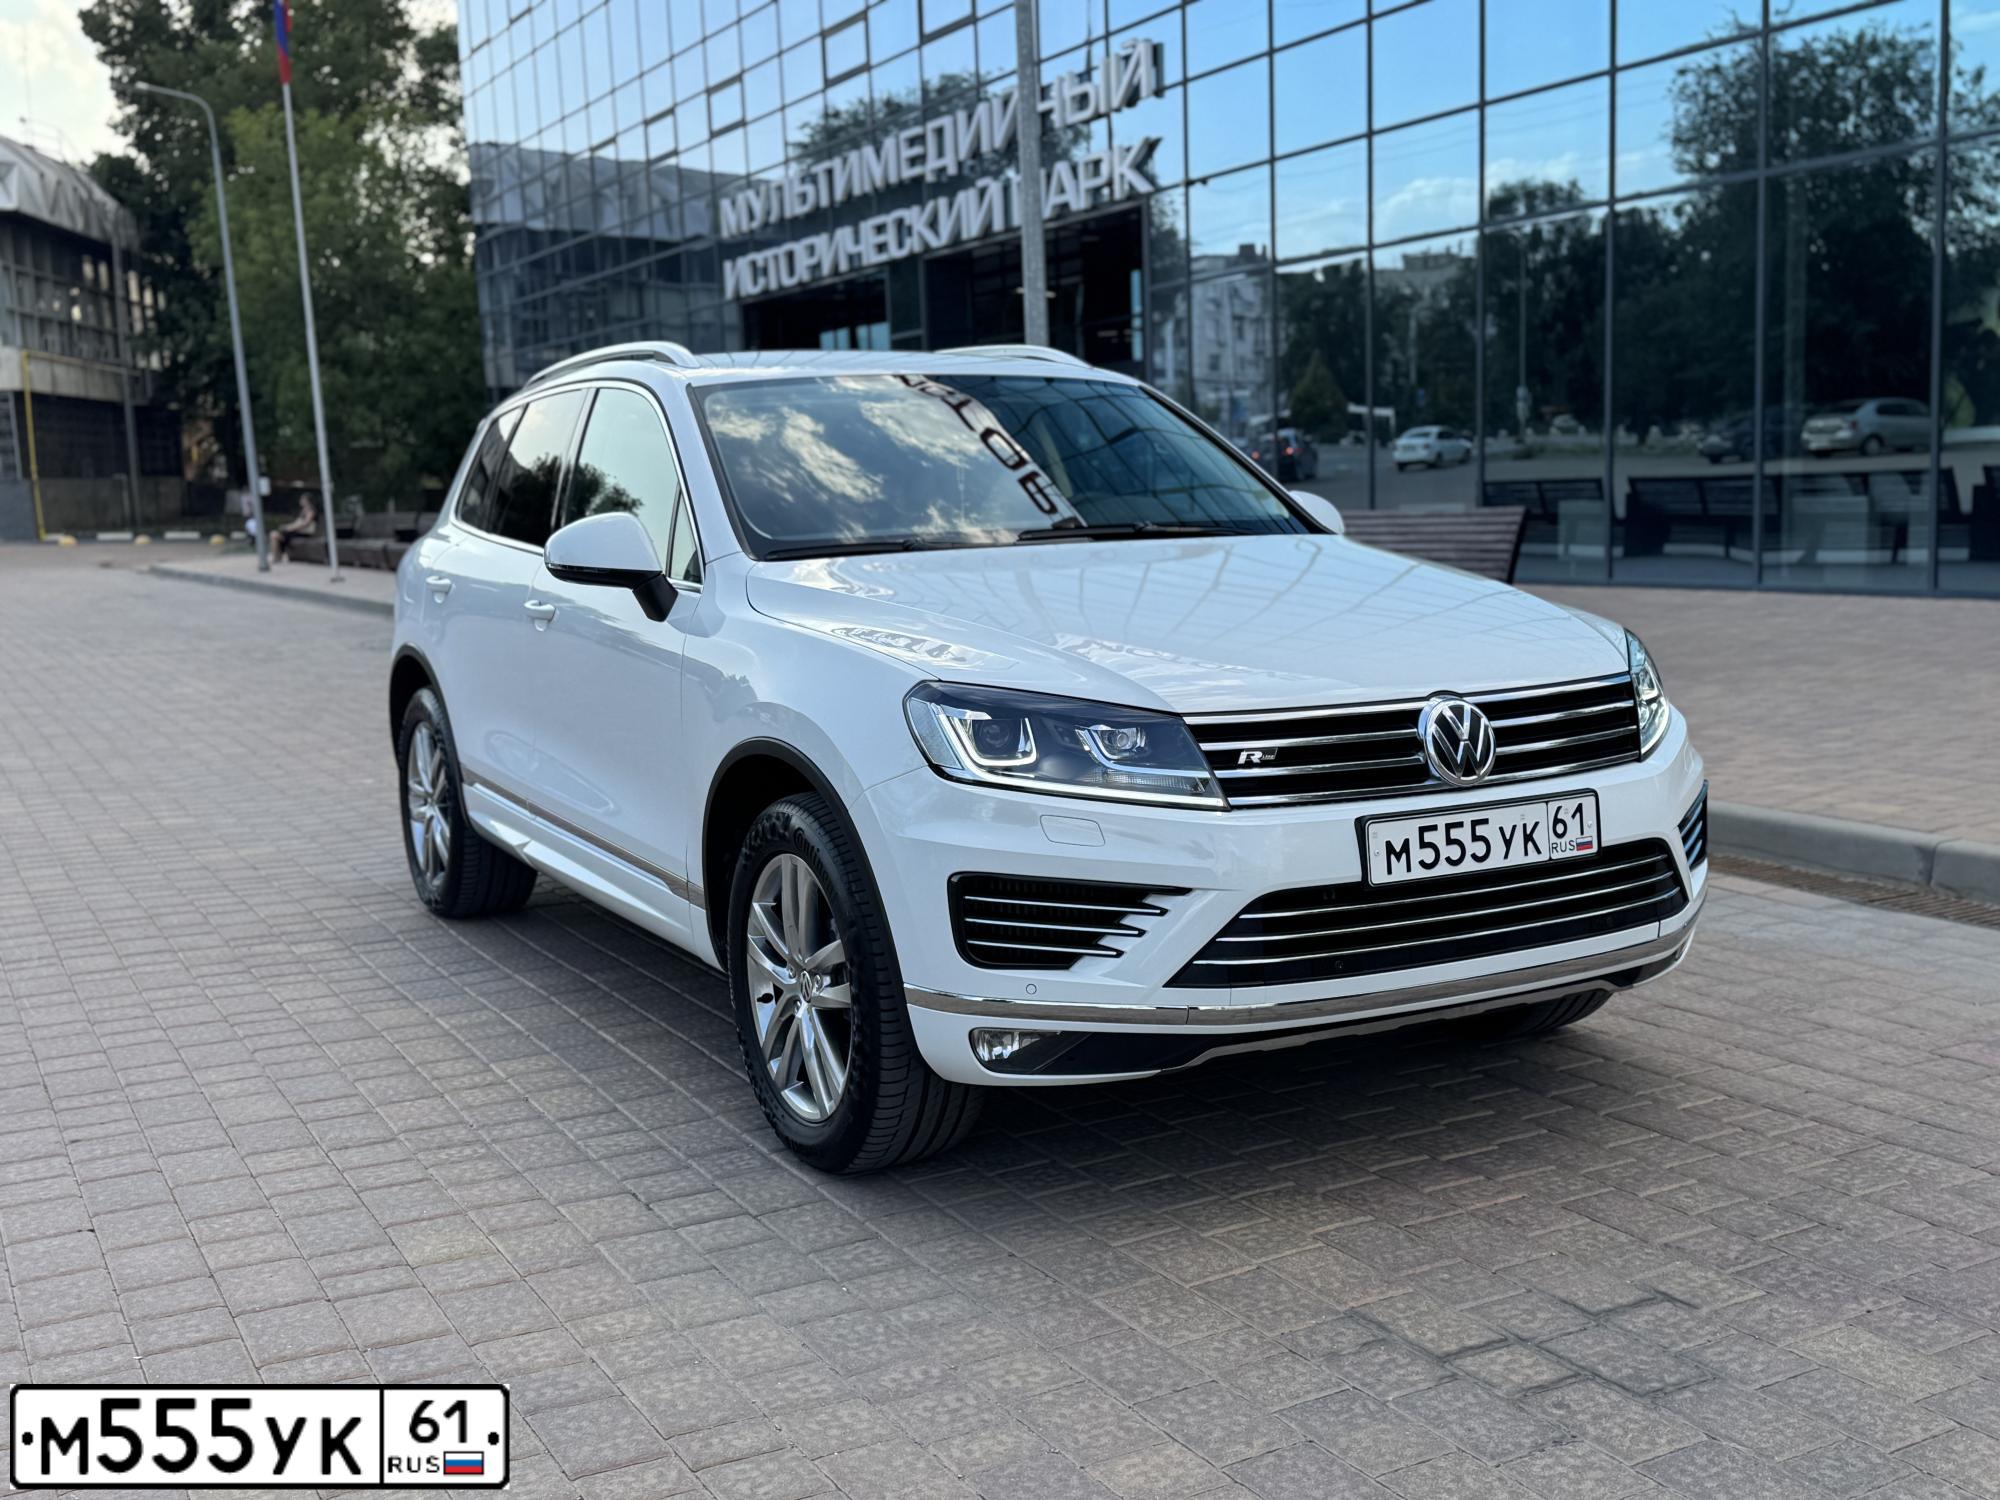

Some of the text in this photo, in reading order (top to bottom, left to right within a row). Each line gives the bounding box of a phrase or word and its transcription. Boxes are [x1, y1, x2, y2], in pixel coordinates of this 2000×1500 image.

[722, 177, 1003, 299] ИСТОРИЧЕСКИЙ
[1385, 803, 1585, 875] М555УК 61
[1551, 840, 1576, 853] RUS
